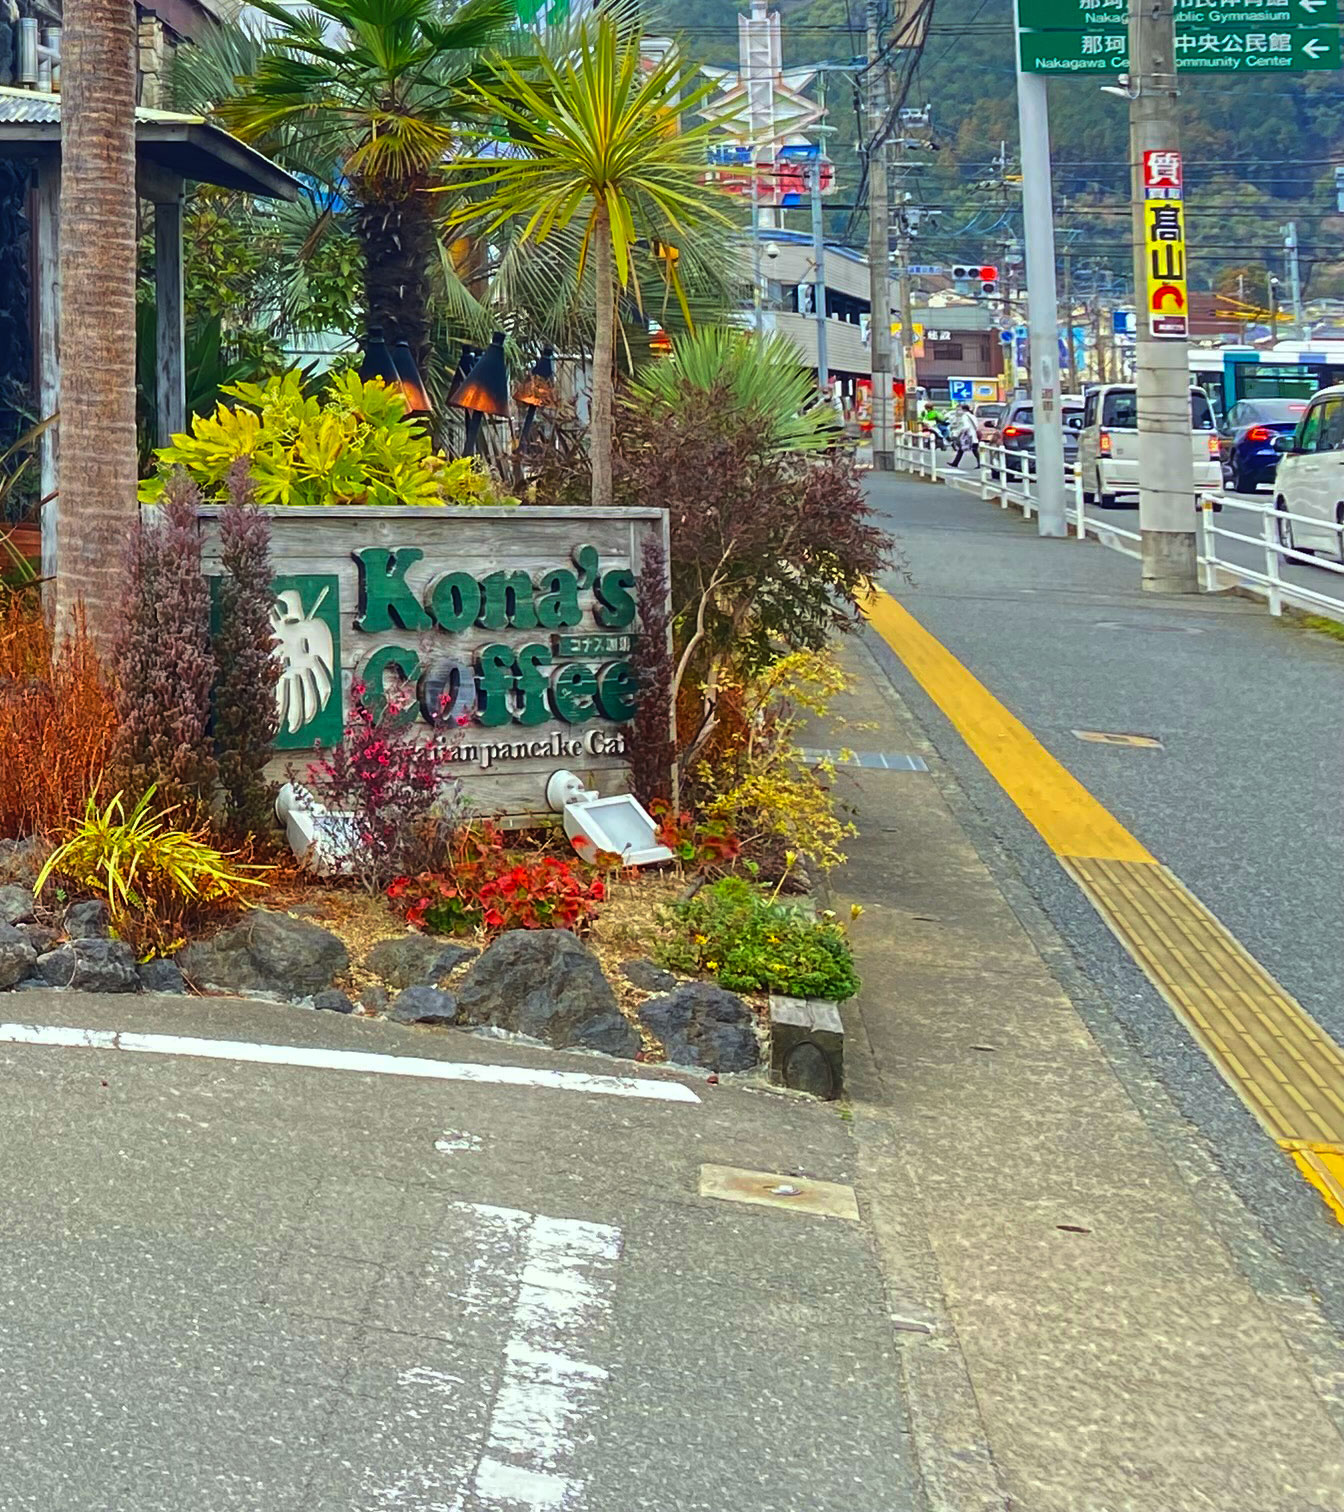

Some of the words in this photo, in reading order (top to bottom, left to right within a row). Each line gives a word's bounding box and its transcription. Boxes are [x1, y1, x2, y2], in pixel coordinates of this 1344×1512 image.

[1085, 12, 1130, 26] Nakag
[1174, 10, 1204, 22] ublic
[1209, 9, 1291, 25] Gymnasium
[1081, 33, 1292, 55] 那珂中央公民館
[1035, 57, 1106, 70] Nakagawa
[1175, 56, 1241, 69] ommunity
[1246, 55, 1293, 67] Center
[1148, 152, 1180, 185] 質
[953, 381, 964, 394] P
[352, 544, 638, 633] Kona's
[361, 643, 639, 728] Coffee
[481, 731, 582, 768] pancake
[584, 729, 626, 755] Ca
